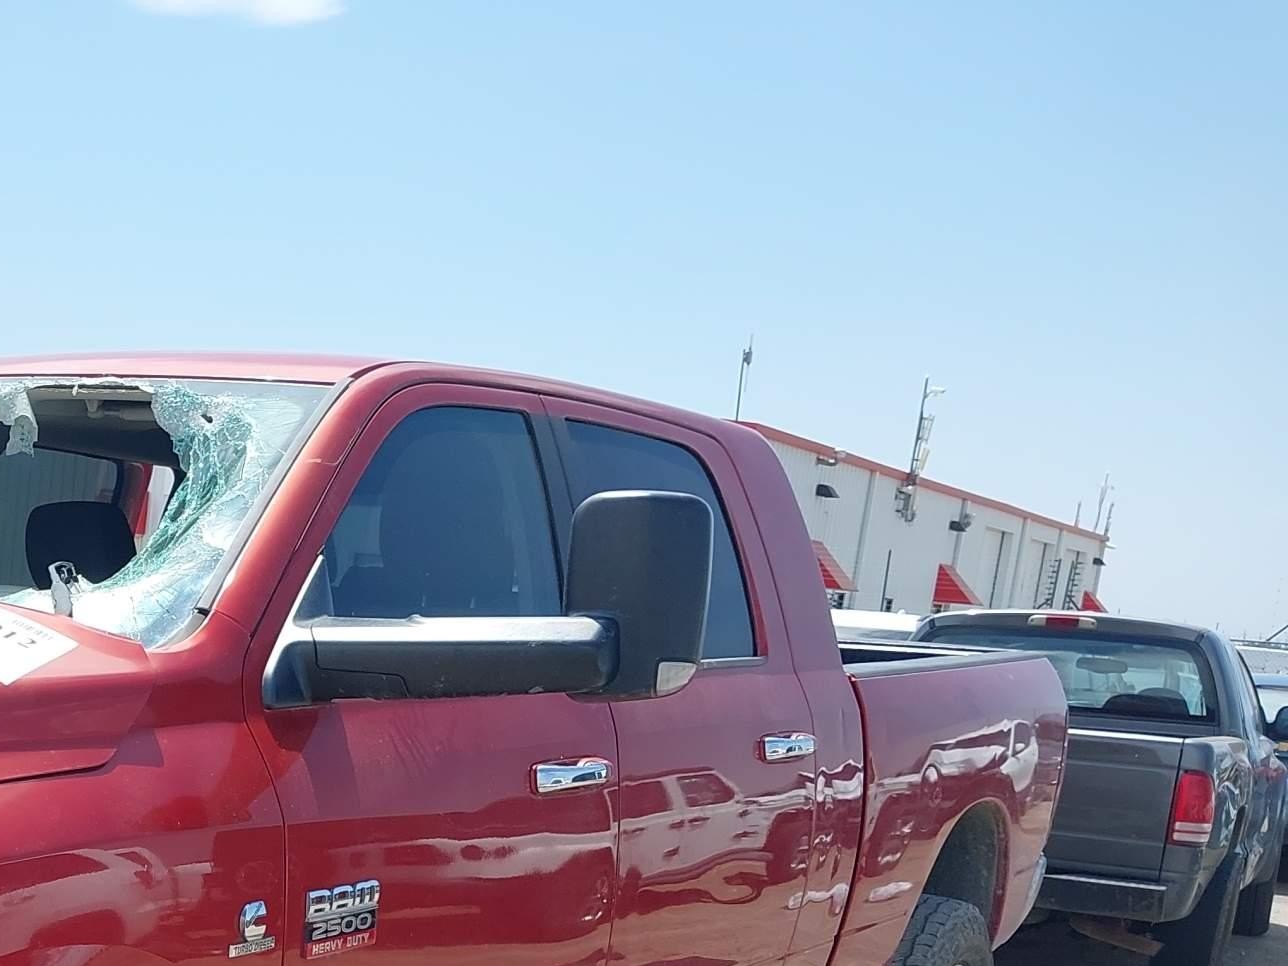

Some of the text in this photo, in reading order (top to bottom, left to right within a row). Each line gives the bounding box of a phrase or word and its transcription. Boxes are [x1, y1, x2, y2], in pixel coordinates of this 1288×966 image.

[307, 880, 380, 918] RAM
[312, 912, 373, 941] 2500
[312, 932, 370, 956] HEAVY DUTY
